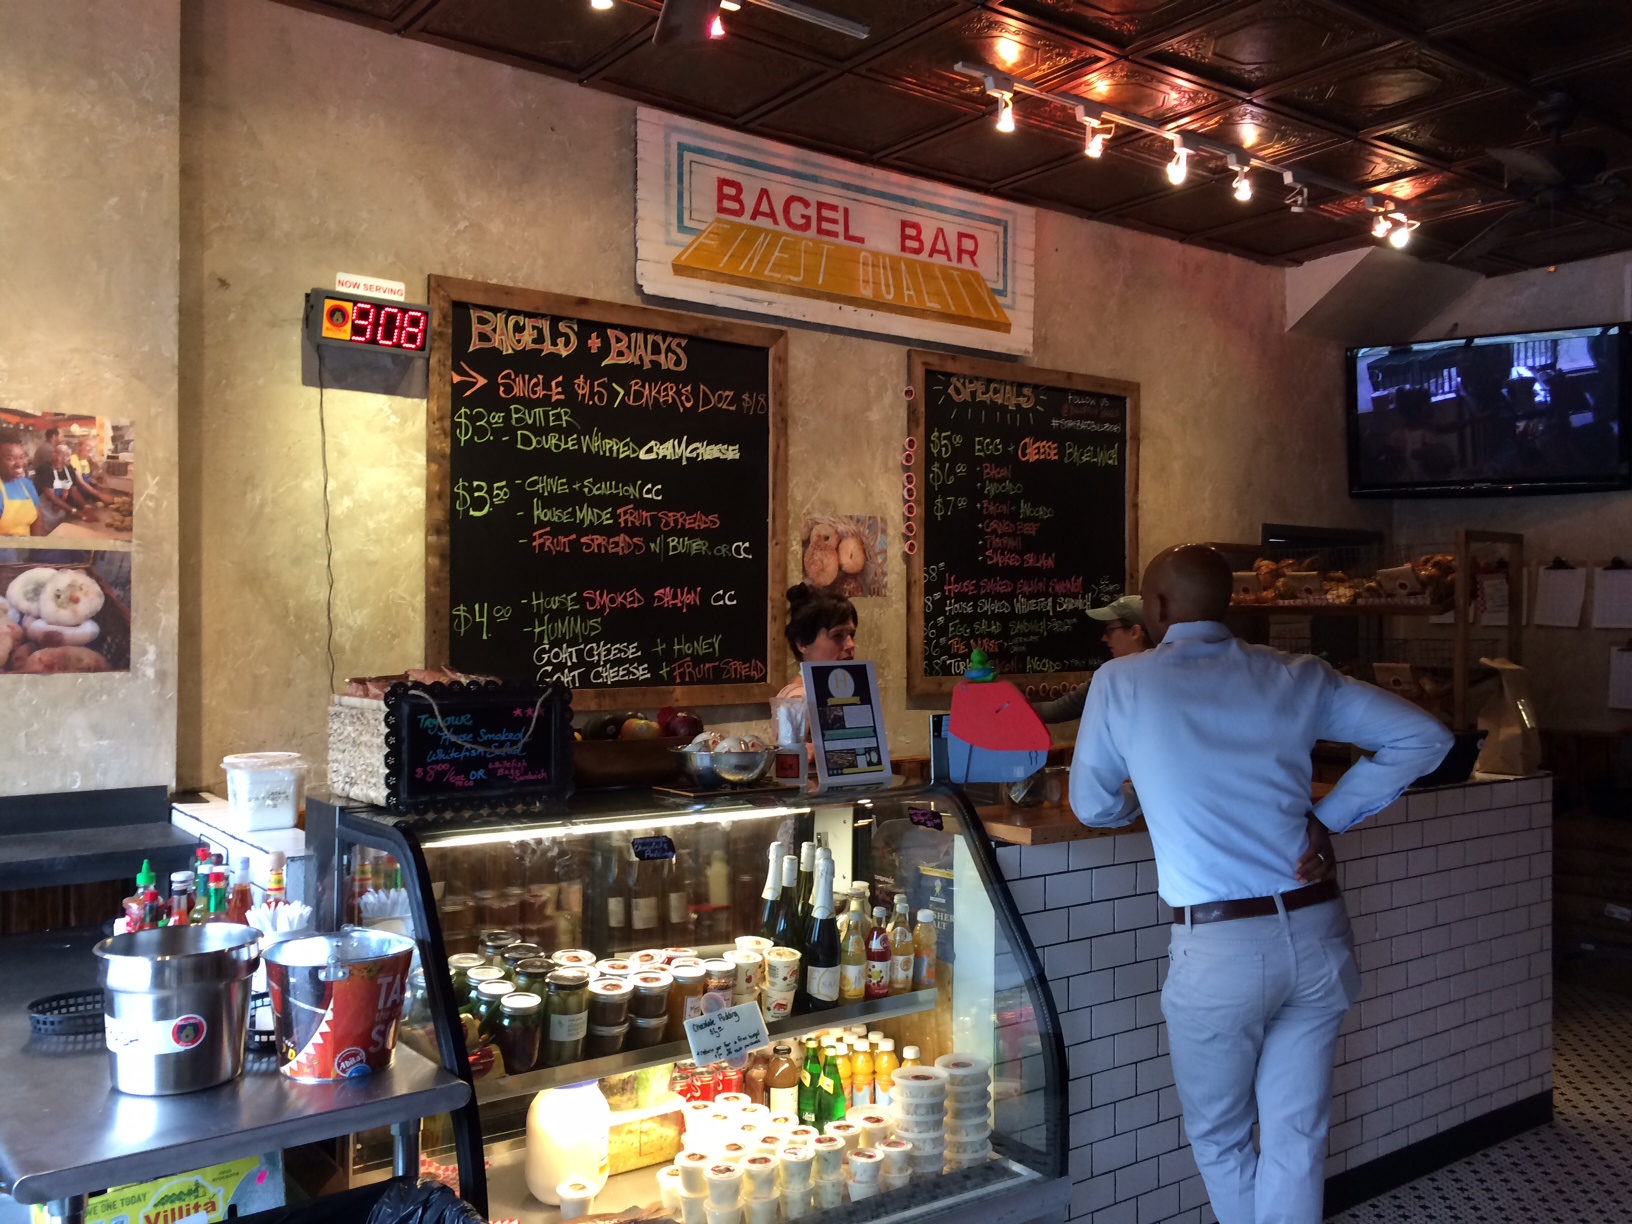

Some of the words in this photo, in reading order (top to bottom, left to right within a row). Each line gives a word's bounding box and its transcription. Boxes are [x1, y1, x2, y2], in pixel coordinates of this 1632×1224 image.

[715, 176, 865, 244] BAGEL
[899, 219, 980, 268] BAR
[680, 222, 836, 285] FINEST
[858, 251, 999, 319] QUALITY
[337, 279, 361, 290] NOW
[363, 283, 404, 297] SERVING
[351, 302, 427, 349] 908
[467, 304, 578, 358] BAGELS
[601, 328, 689, 372] BIALYS
[498, 369, 564, 401] SINGLE
[697, 382, 737, 412] DOZ
[948, 375, 1036, 410] SPECIALS
[510, 404, 581, 429] BUTTER
[516, 430, 578, 452] DOUBLE
[581, 427, 639, 460] WHIPPED
[974, 436, 1003, 457] EGG
[1018, 436, 1059, 463] CHEESE
[524, 476, 569, 495] CHIVE
[616, 504, 657, 528] FRUIT
[660, 510, 720, 530] SPREADS
[1017, 521, 1041, 537] BEEF
[532, 527, 577, 554] FRUIT
[580, 532, 646, 556] SPREADS
[985, 549, 1021, 566] SMOKED
[944, 573, 977, 596] HOUSE
[979, 576, 1014, 596] SMOKED
[531, 590, 580, 613] HOUSE
[582, 588, 645, 615] SMOKED
[653, 586, 702, 613] SALMON
[710, 590, 737, 607] CC
[945, 598, 975, 616] HOUSE
[976, 596, 1012, 615] SMOKED
[533, 617, 602, 644] HUMMUS
[948, 618, 971, 637] EGG
[974, 619, 1003, 635] SALAD
[672, 634, 722, 658] HONEY
[948, 637, 968, 655] THE
[590, 663, 651, 684] CHEESE
[671, 657, 718, 683] FRUIT
[720, 658, 766, 681] SPREAD
[1026, 656, 1062, 674] AVOCADO
[477, 727, 526, 742] Smoked
[426, 747, 485, 763] Whitefish
[469, 769, 487, 780] OR
[120, 1193, 148, 1207] TODAY
